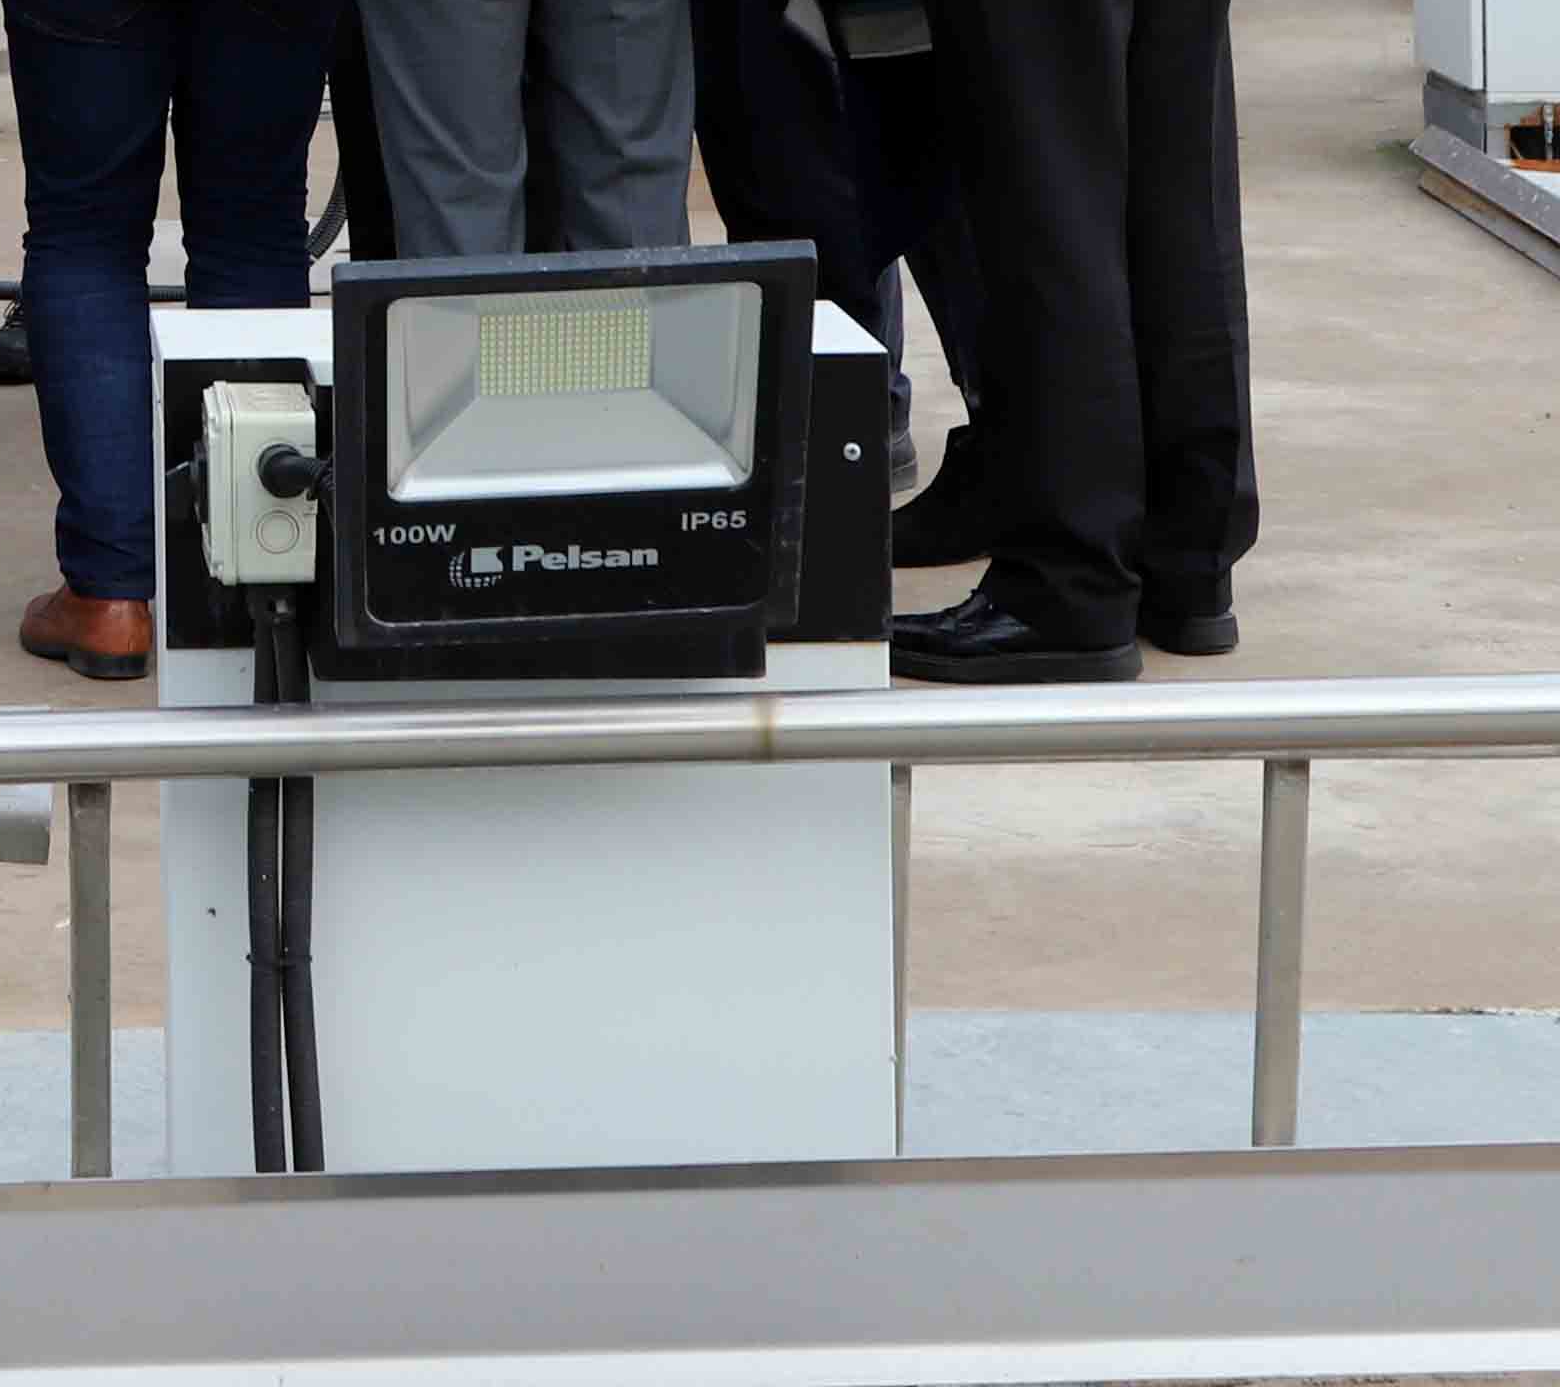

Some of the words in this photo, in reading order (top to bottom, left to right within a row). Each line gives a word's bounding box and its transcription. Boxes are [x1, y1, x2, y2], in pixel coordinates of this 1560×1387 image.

[373, 524, 457, 546] 100W
[681, 510, 747, 531] IP65
[511, 544, 659, 572] Pelsan
